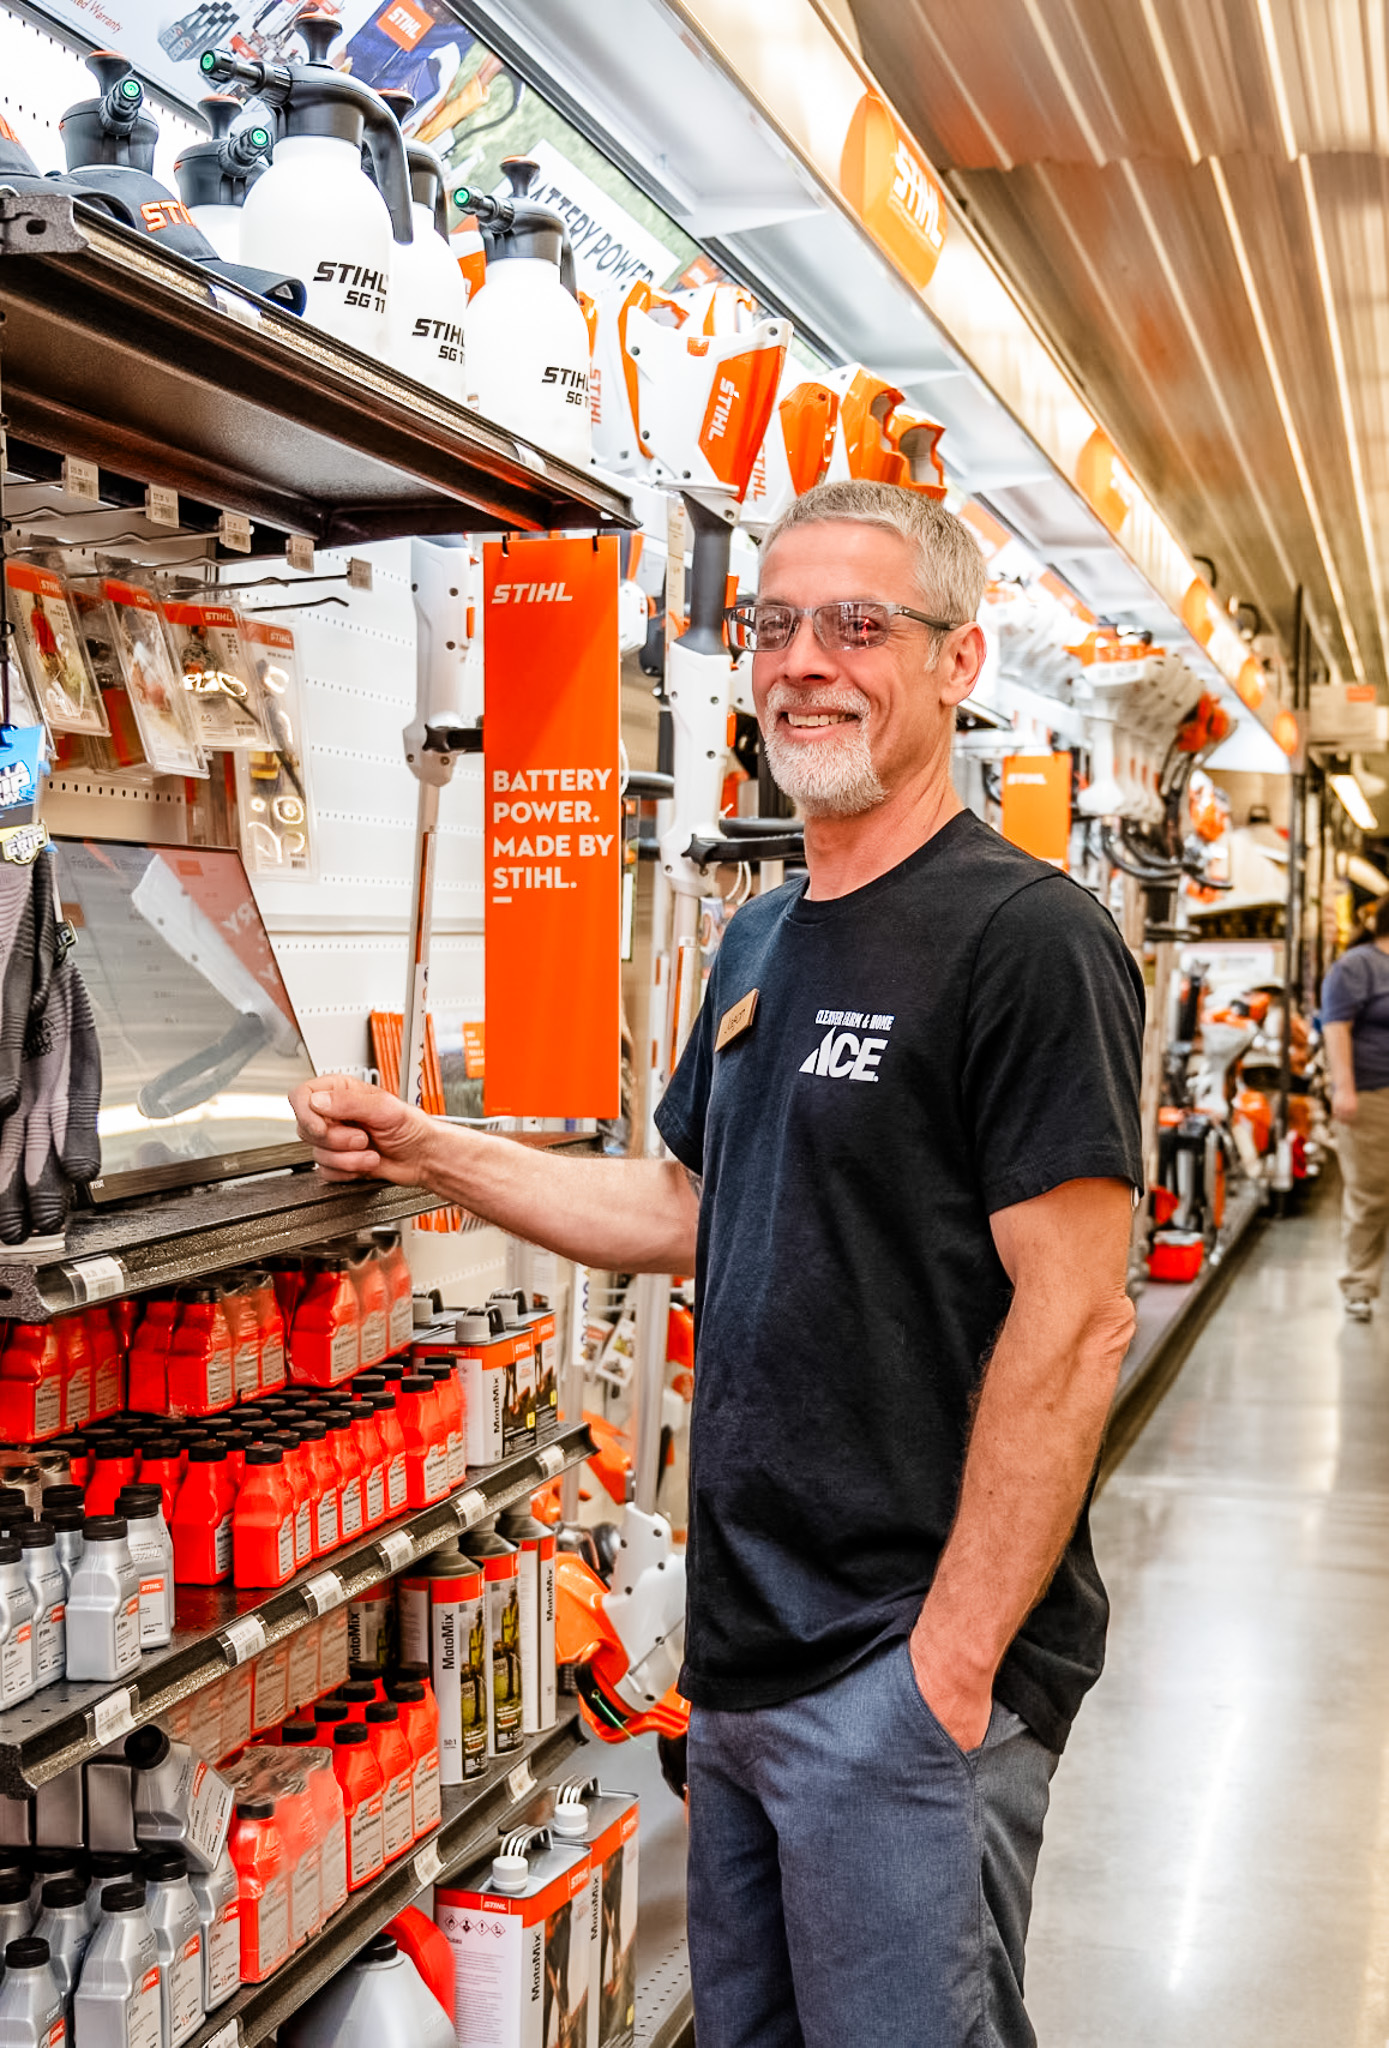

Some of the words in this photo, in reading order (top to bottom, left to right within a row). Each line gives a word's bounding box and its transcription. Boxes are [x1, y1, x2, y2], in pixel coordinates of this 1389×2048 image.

[387, 6, 422, 40] STIHL
[893, 139, 943, 248] STIHL
[344, 290, 371, 308] SG
[438, 345, 458, 362] SG
[565, 390, 583, 406] SG
[708, 376, 735, 441] STIHL
[491, 582, 573, 604] STIHL
[204, 612, 233, 623] STIHL
[269, 633, 292, 645] STIHL
[493, 768, 613, 792] BATTERY
[493, 800, 600, 824] POWER.
[493, 834, 571, 858] MADE
[579, 834, 615, 857] BY
[492, 866, 578, 889] STIHL.
[861, 1014, 870, 1029] &
[868, 1014, 895, 1031] HOME
[141, 1584, 161, 1592] STIHL
[442, 1612, 455, 1670] MotoMix
[570, 1869, 589, 1890] STIHL
[223, 1905, 239, 1920] STIHL
[484, 1901, 507, 1911] STIHL
[591, 1874, 599, 1942] MotoMix
[531, 1932, 541, 2002] MotoMix
[143, 1972, 158, 1989] STIHL
[50, 2025, 65, 2043] STIHL
